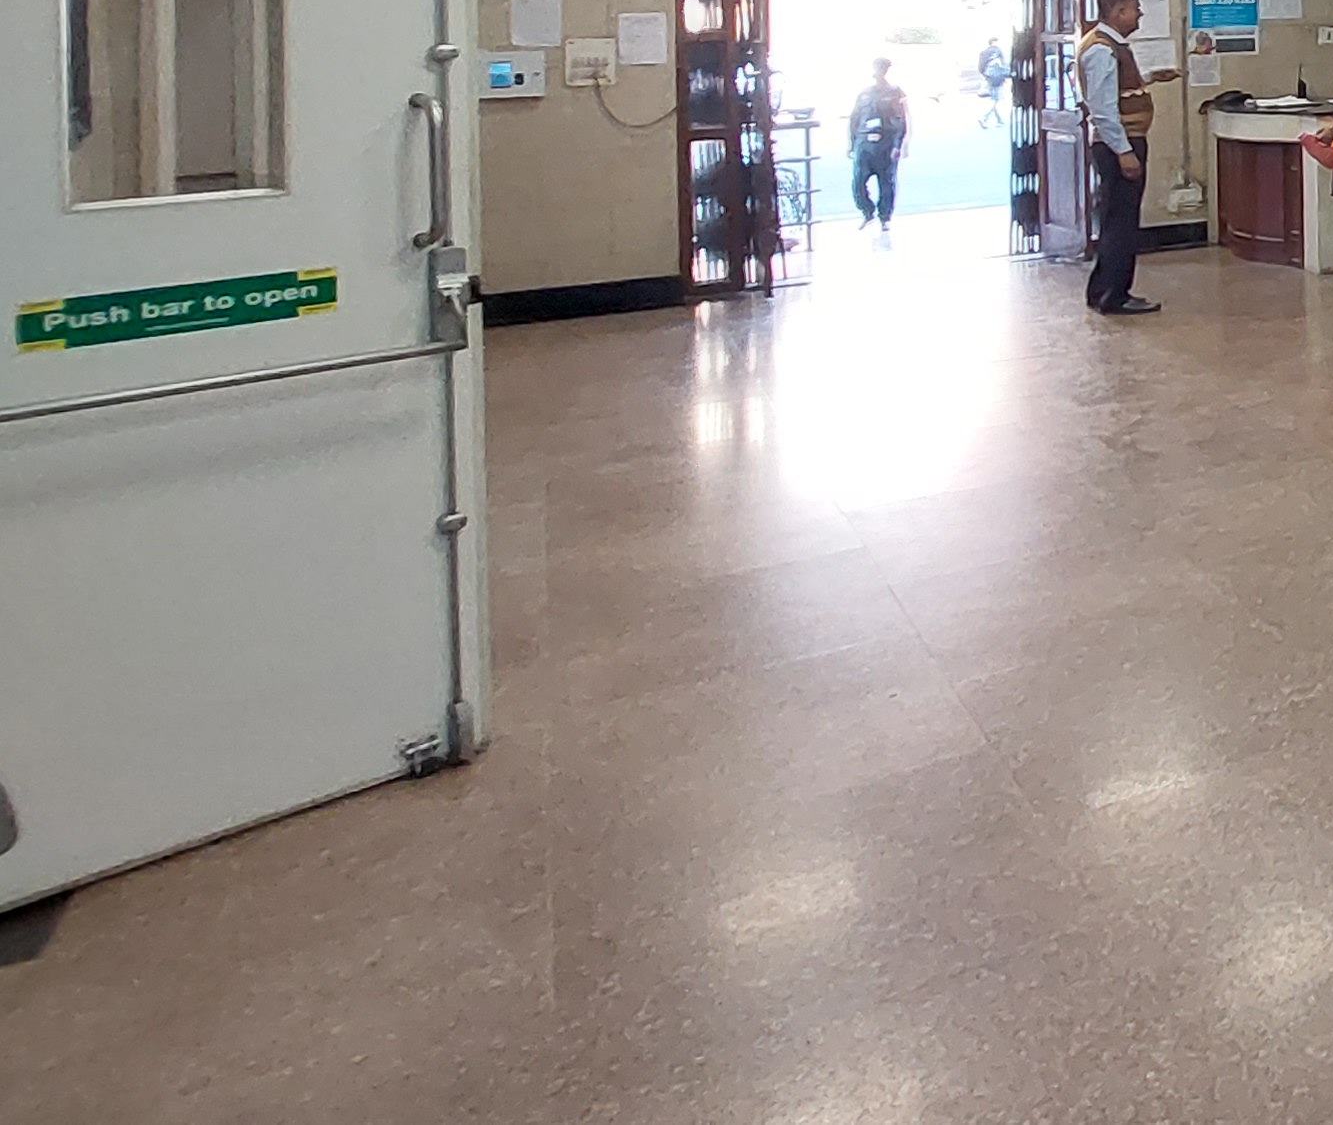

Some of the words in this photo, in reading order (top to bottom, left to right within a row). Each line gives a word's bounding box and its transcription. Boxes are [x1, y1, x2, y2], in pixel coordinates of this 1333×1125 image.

[42, 305, 130, 332] Push
[141, 298, 195, 320] bar
[203, 294, 236, 312] to
[244, 284, 318, 309] open
